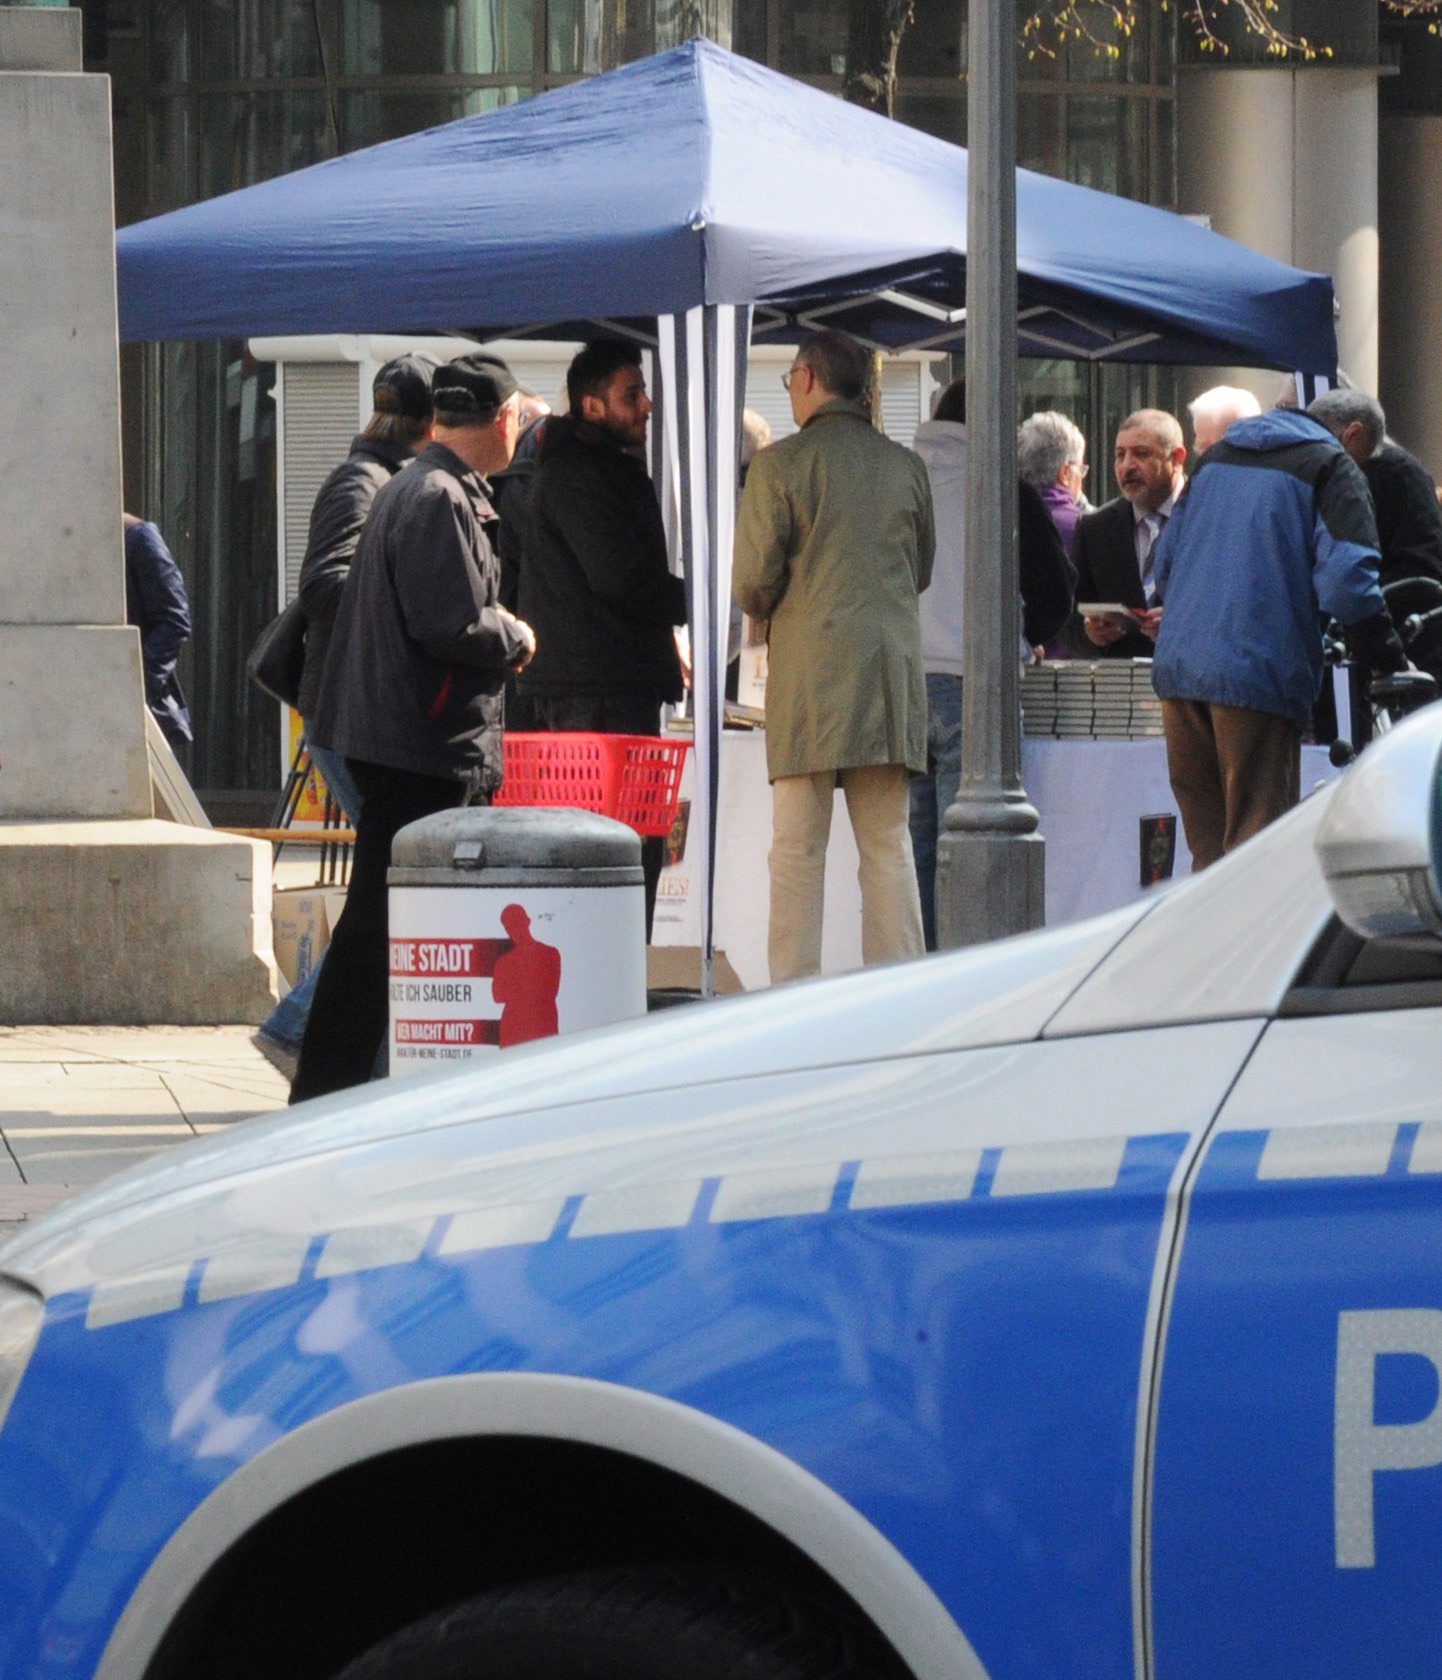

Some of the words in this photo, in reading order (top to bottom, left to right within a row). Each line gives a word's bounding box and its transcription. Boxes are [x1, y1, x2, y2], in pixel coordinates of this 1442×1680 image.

[418, 943, 473, 972] STADT
[423, 984, 472, 1002] SAUBER
[411, 1022, 443, 1041] MACHT
[445, 1022, 474, 1042] MIT?
